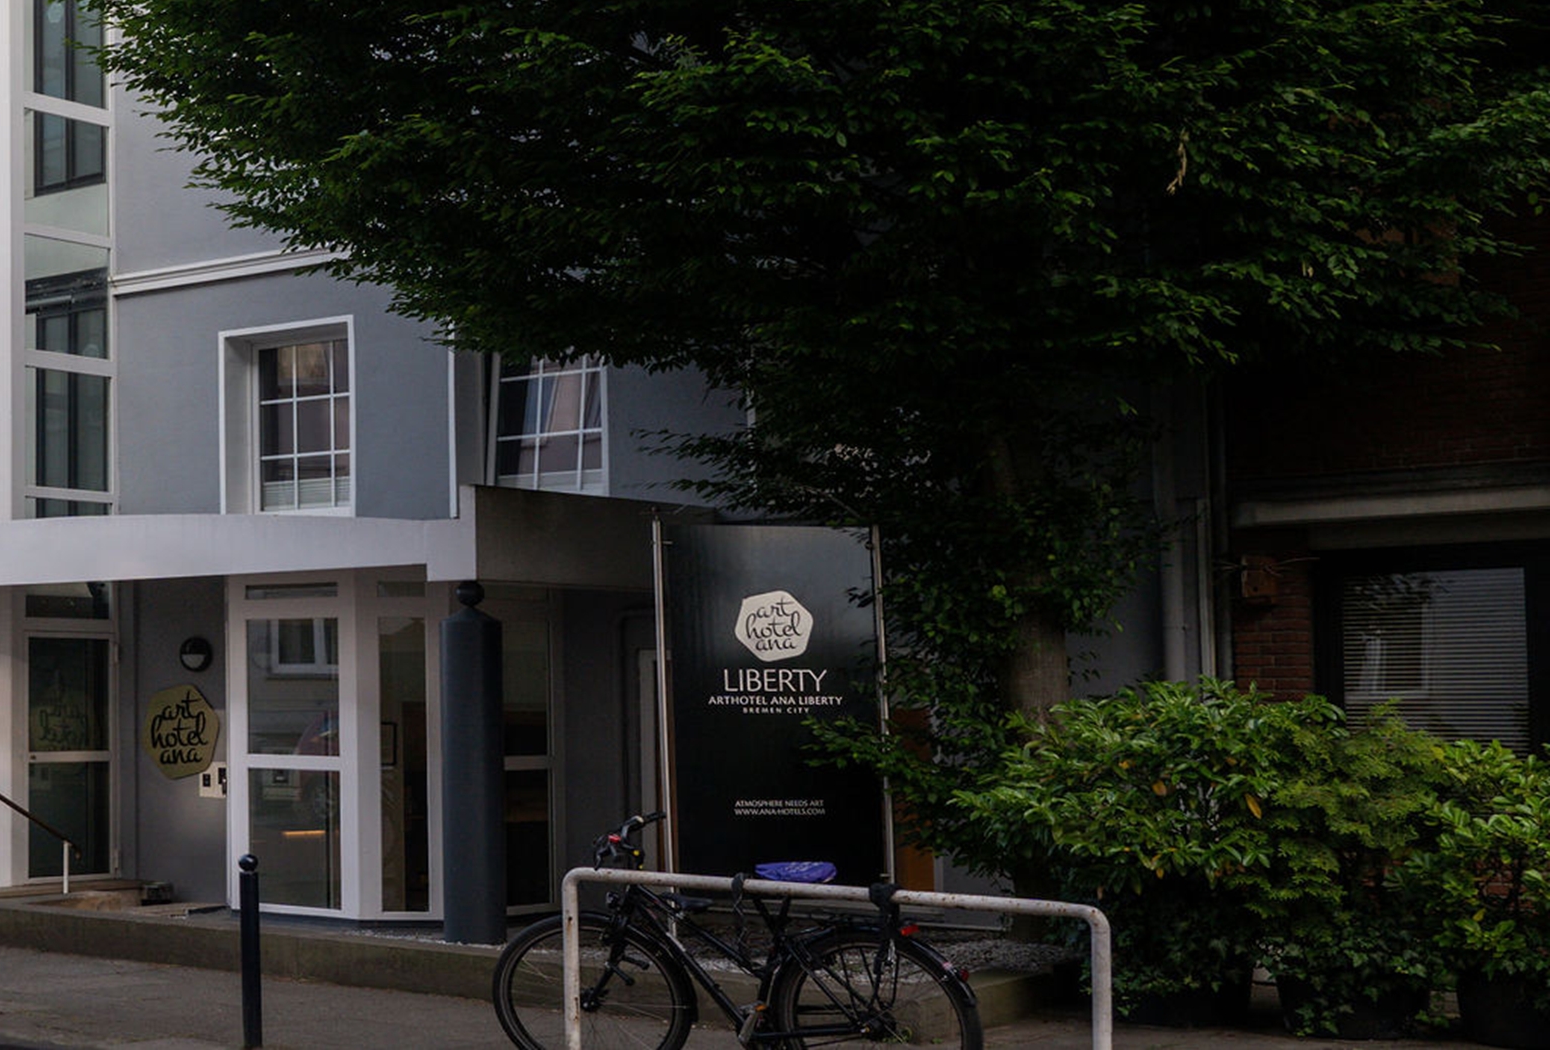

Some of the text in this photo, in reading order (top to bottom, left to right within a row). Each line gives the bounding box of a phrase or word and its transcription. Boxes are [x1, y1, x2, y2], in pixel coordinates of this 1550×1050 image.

[756, 596, 795, 619] art
[745, 610, 803, 640] hotel
[755, 638, 796, 652] ana
[723, 668, 827, 692] LIBERTY
[162, 690, 203, 720] art
[708, 695, 843, 705] ARTHOTEL ANA LIBERTY
[151, 711, 208, 748] hotel
[160, 747, 203, 765] ana
